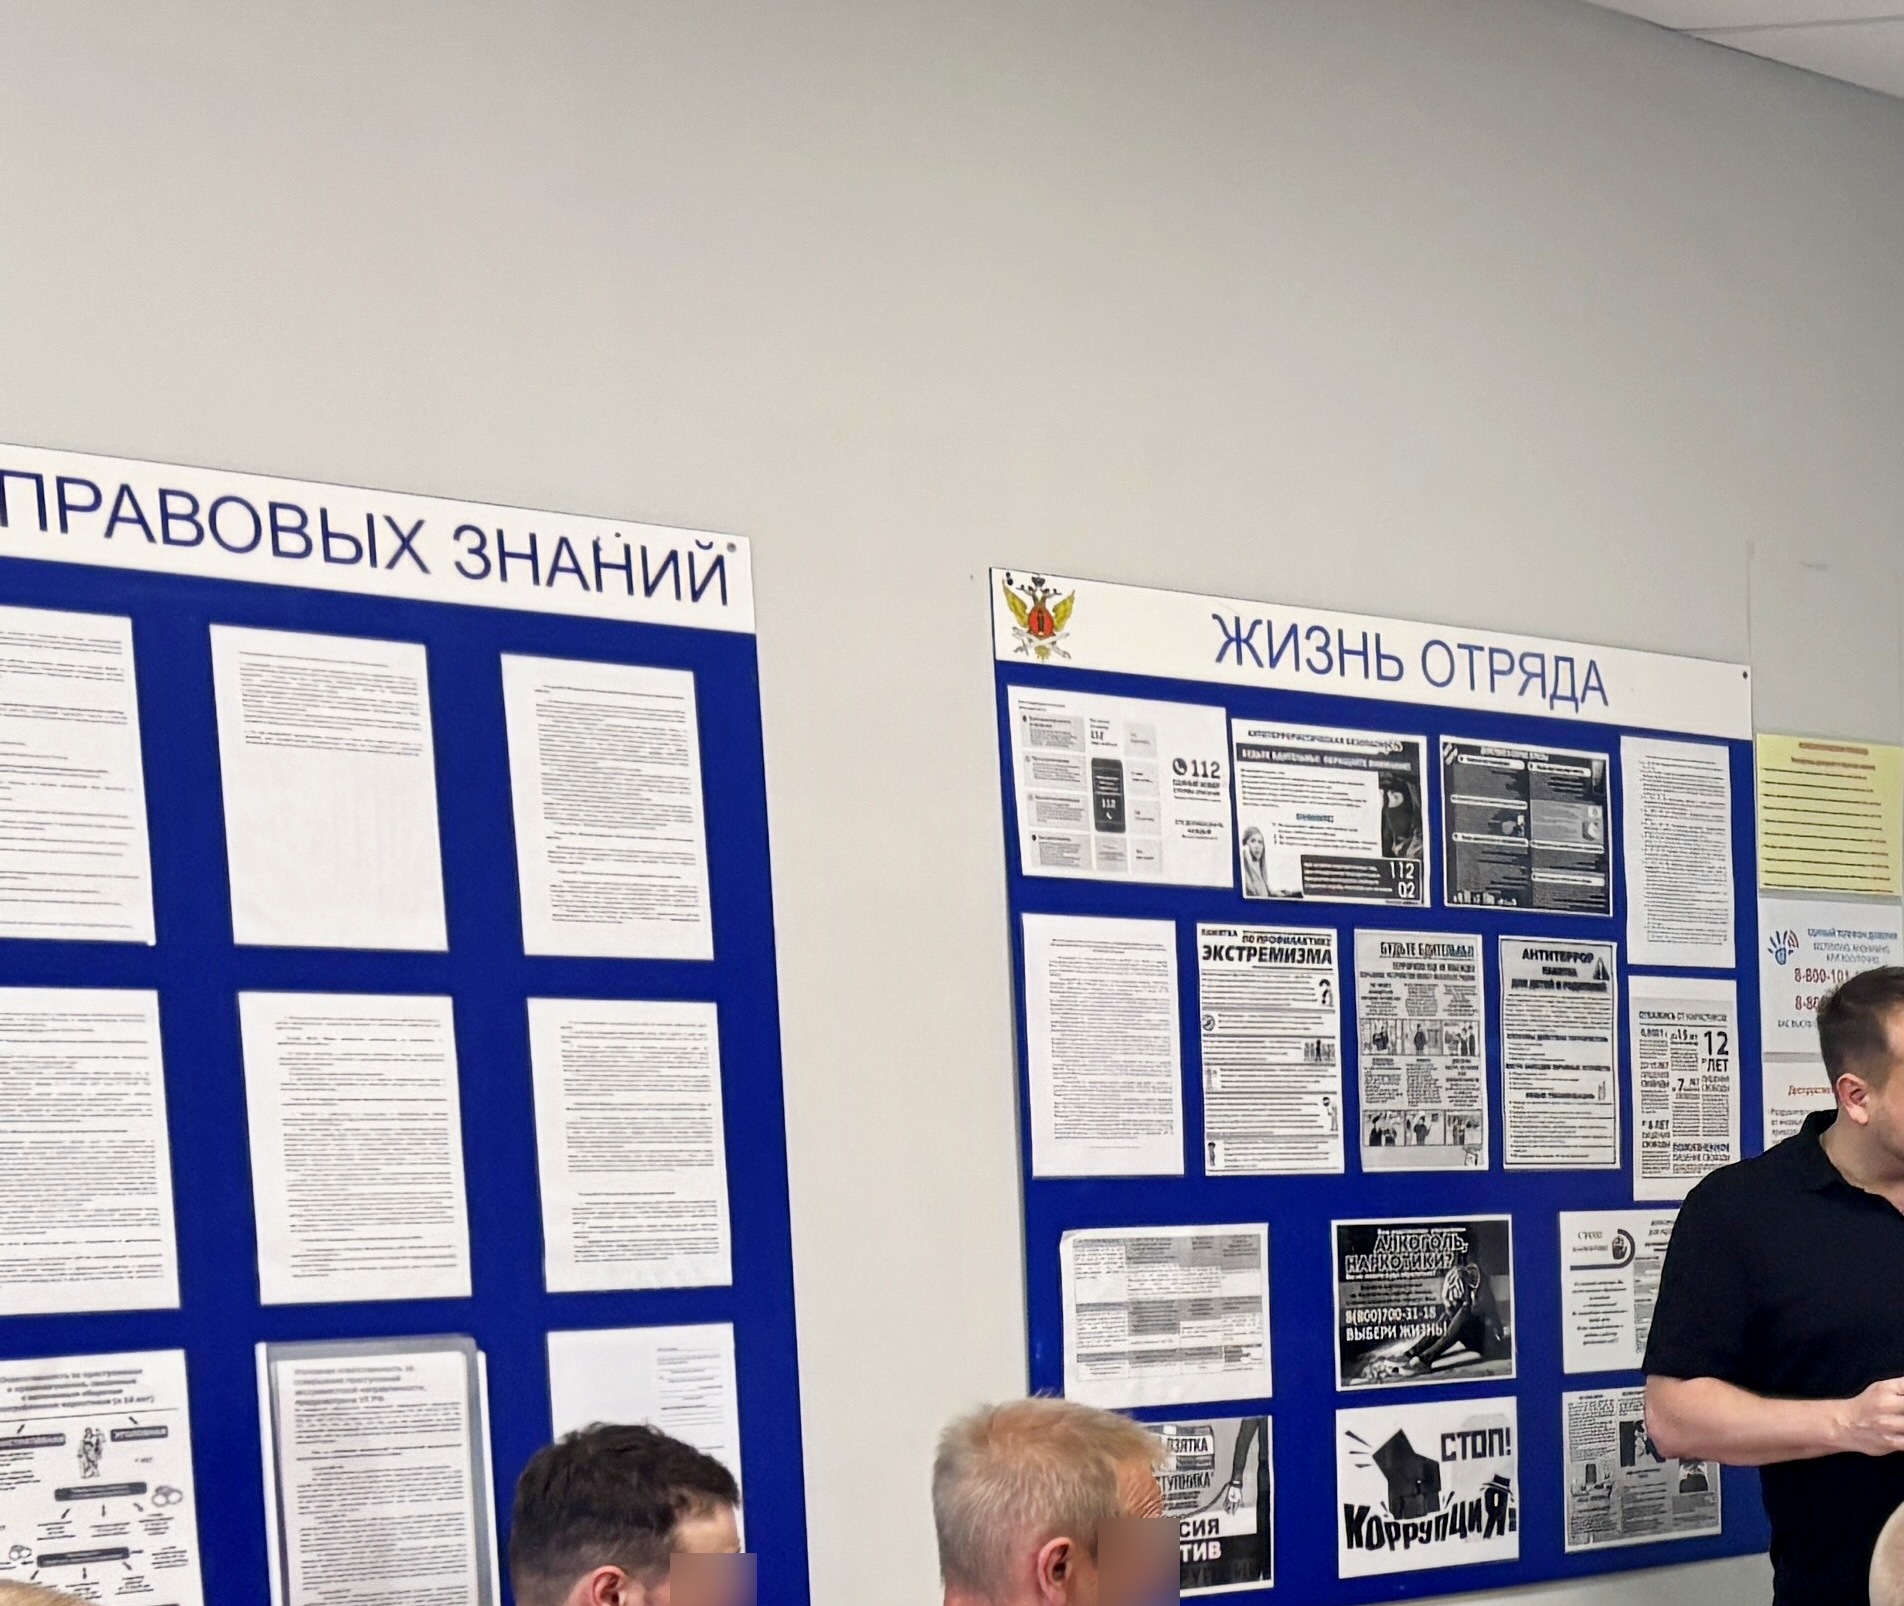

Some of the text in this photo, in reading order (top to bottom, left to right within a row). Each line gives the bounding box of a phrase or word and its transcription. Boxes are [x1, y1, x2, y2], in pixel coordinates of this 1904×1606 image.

[0, 469, 728, 607] ПРАВОВЫХ ЗНАНИЙ
[1212, 613, 1609, 714] ЖИЗНЬ ОТРЯДА
[1193, 759, 1221, 779] 112
[1390, 861, 1415, 879] 112
[1398, 882, 1416, 899] 02
[1202, 944, 1333, 965] ЭКСТРЕМИЗМА
[1522, 948, 1594, 964] АНТИТЕРРОР
[1704, 1031, 1729, 1056] 12
[1707, 1058, 1729, 1072] ЛЕТ
[1345, 1251, 1456, 1274] НАРКОТИКИ?
[1346, 1325, 1397, 1342] ВЫБЕРИ
[1440, 1427, 1511, 1462] СТОП!
